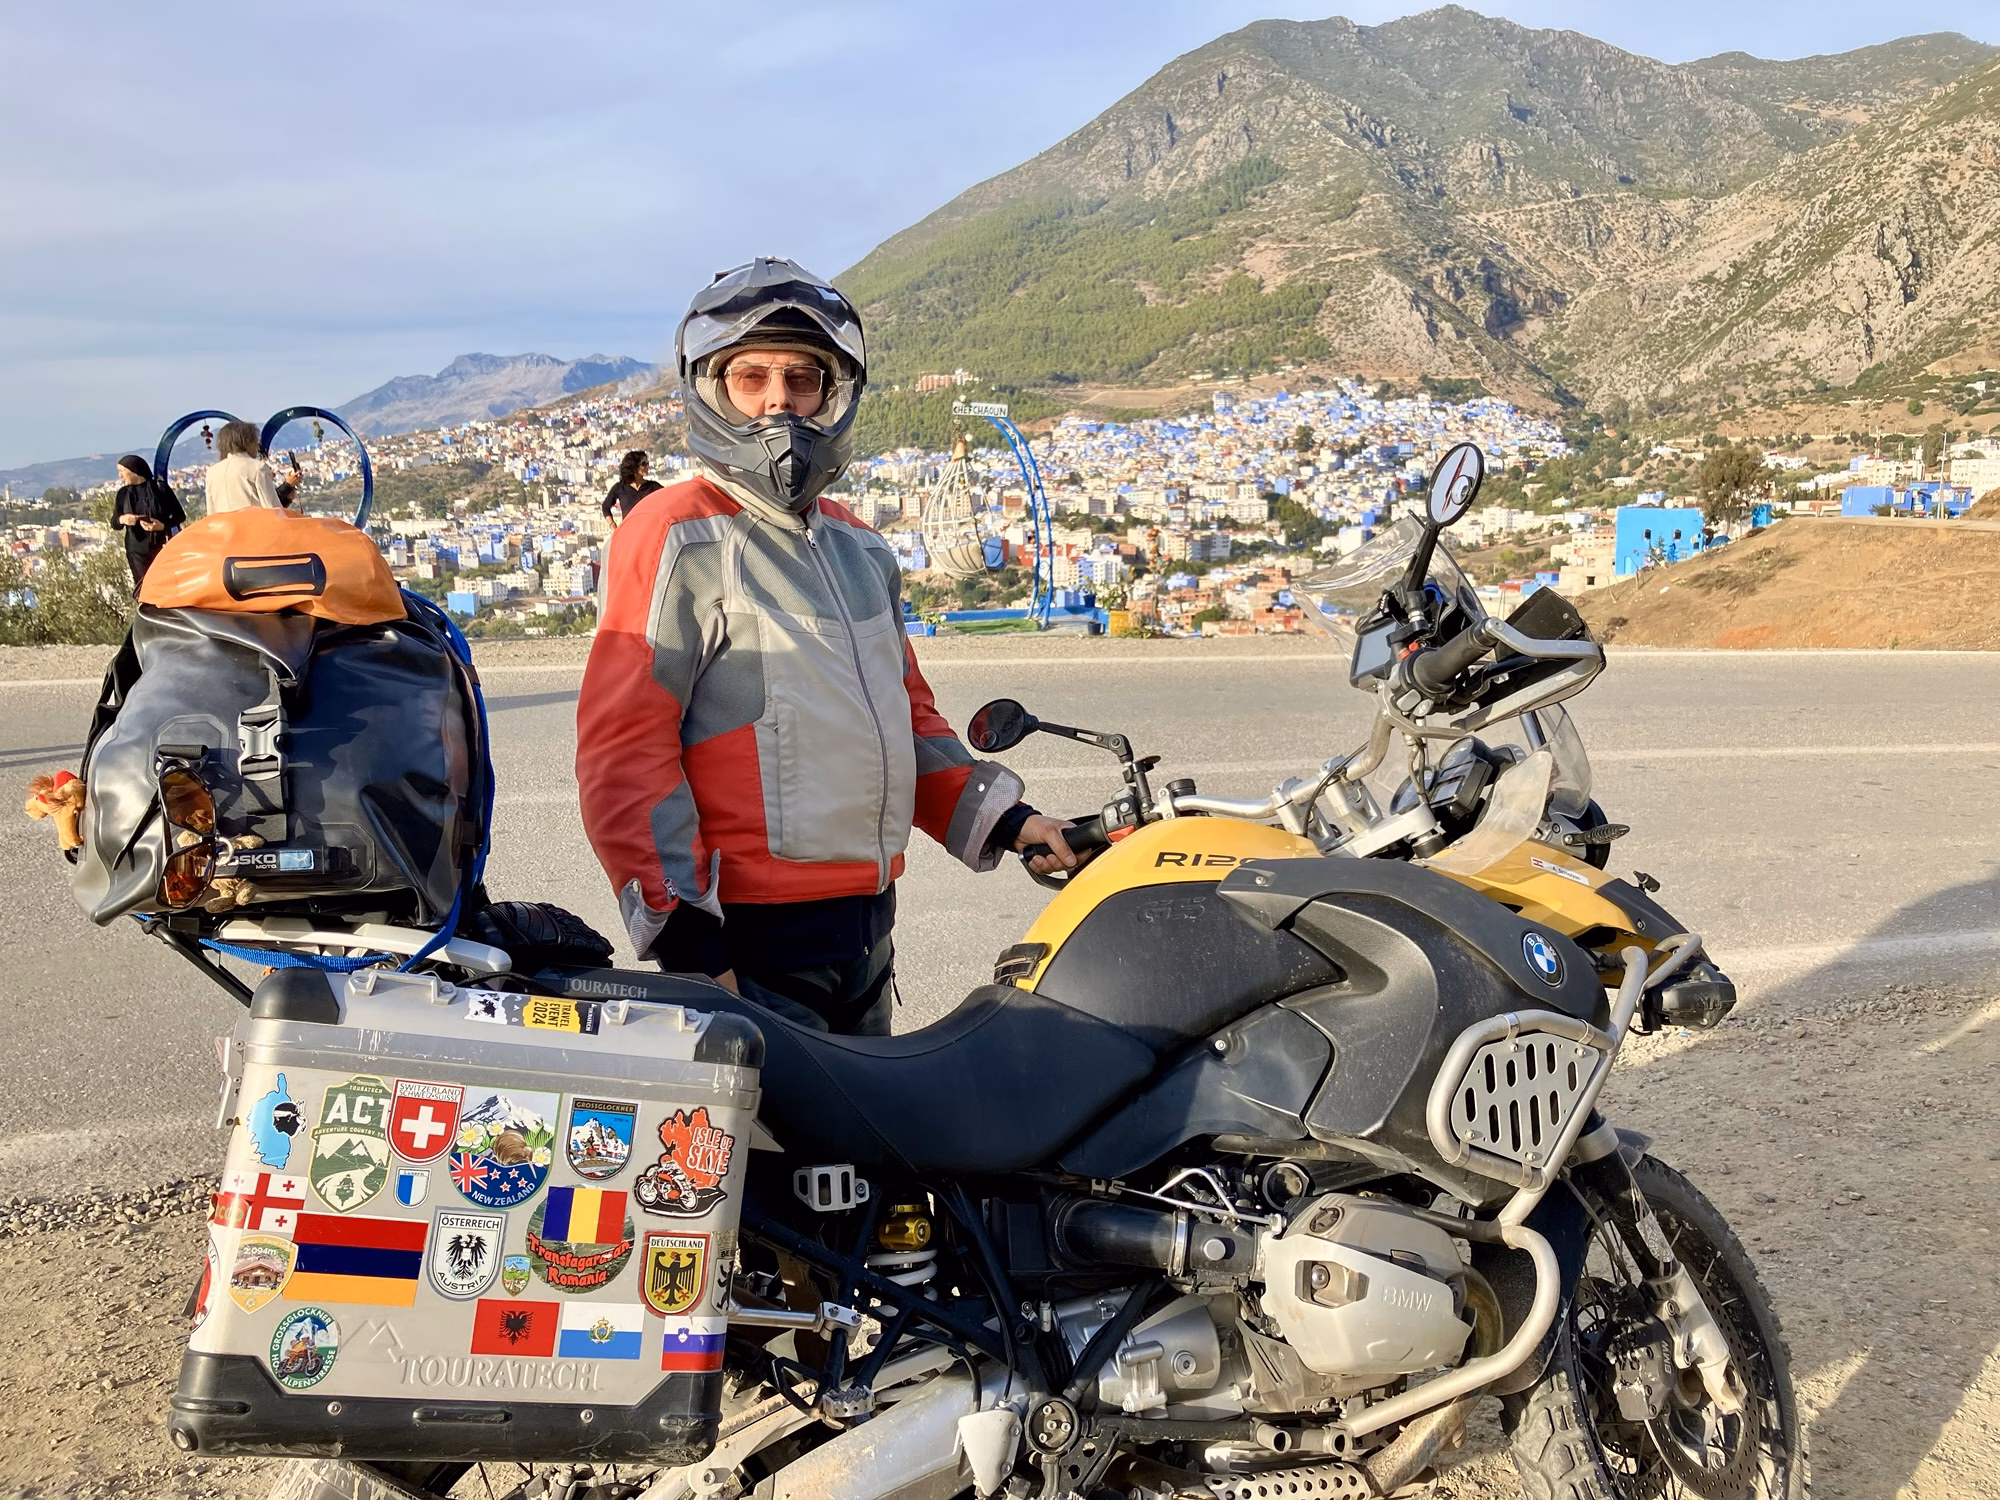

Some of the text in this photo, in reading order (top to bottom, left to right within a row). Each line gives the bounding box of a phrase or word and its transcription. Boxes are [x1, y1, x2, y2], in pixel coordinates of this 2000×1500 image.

[1155, 852, 1258, 867] R12
[1527, 935, 1557, 956] BMW
[562, 978, 647, 999] TOURATECH
[532, 1001, 548, 1025] 2024
[548, 1003, 560, 1027] EVENT
[560, 1004, 571, 1027] TRAVEL
[350, 1085, 383, 1094] TOURATECH
[400, 1083, 461, 1096] SWITZERLAND
[576, 1101, 635, 1113] GROSSGLOCKNER
[314, 1126, 348, 1136] ADVENTURE
[350, 1127, 376, 1136] COUNTRY
[693, 1127, 733, 1150] ISLE OF
[687, 1143, 731, 1175] SKYE
[471, 1182, 536, 1206] NEW ZEALAND
[441, 1214, 500, 1229] ÖSTERREICH
[243, 1247, 277, 1255] 2.094m
[651, 1238, 703, 1248] DEUTSCHLAND
[438, 1271, 487, 1291] AUSTRIA
[548, 1265, 607, 1288] Romania
[1383, 1285, 1433, 1312] BMW
[272, 1307, 332, 1351] GROSSGLOCKNER
[281, 1349, 336, 1388] ALPENSTRASSE
[1661, 1340, 1672, 1375] BMW
[400, 1355, 601, 1391] TOURATECH
